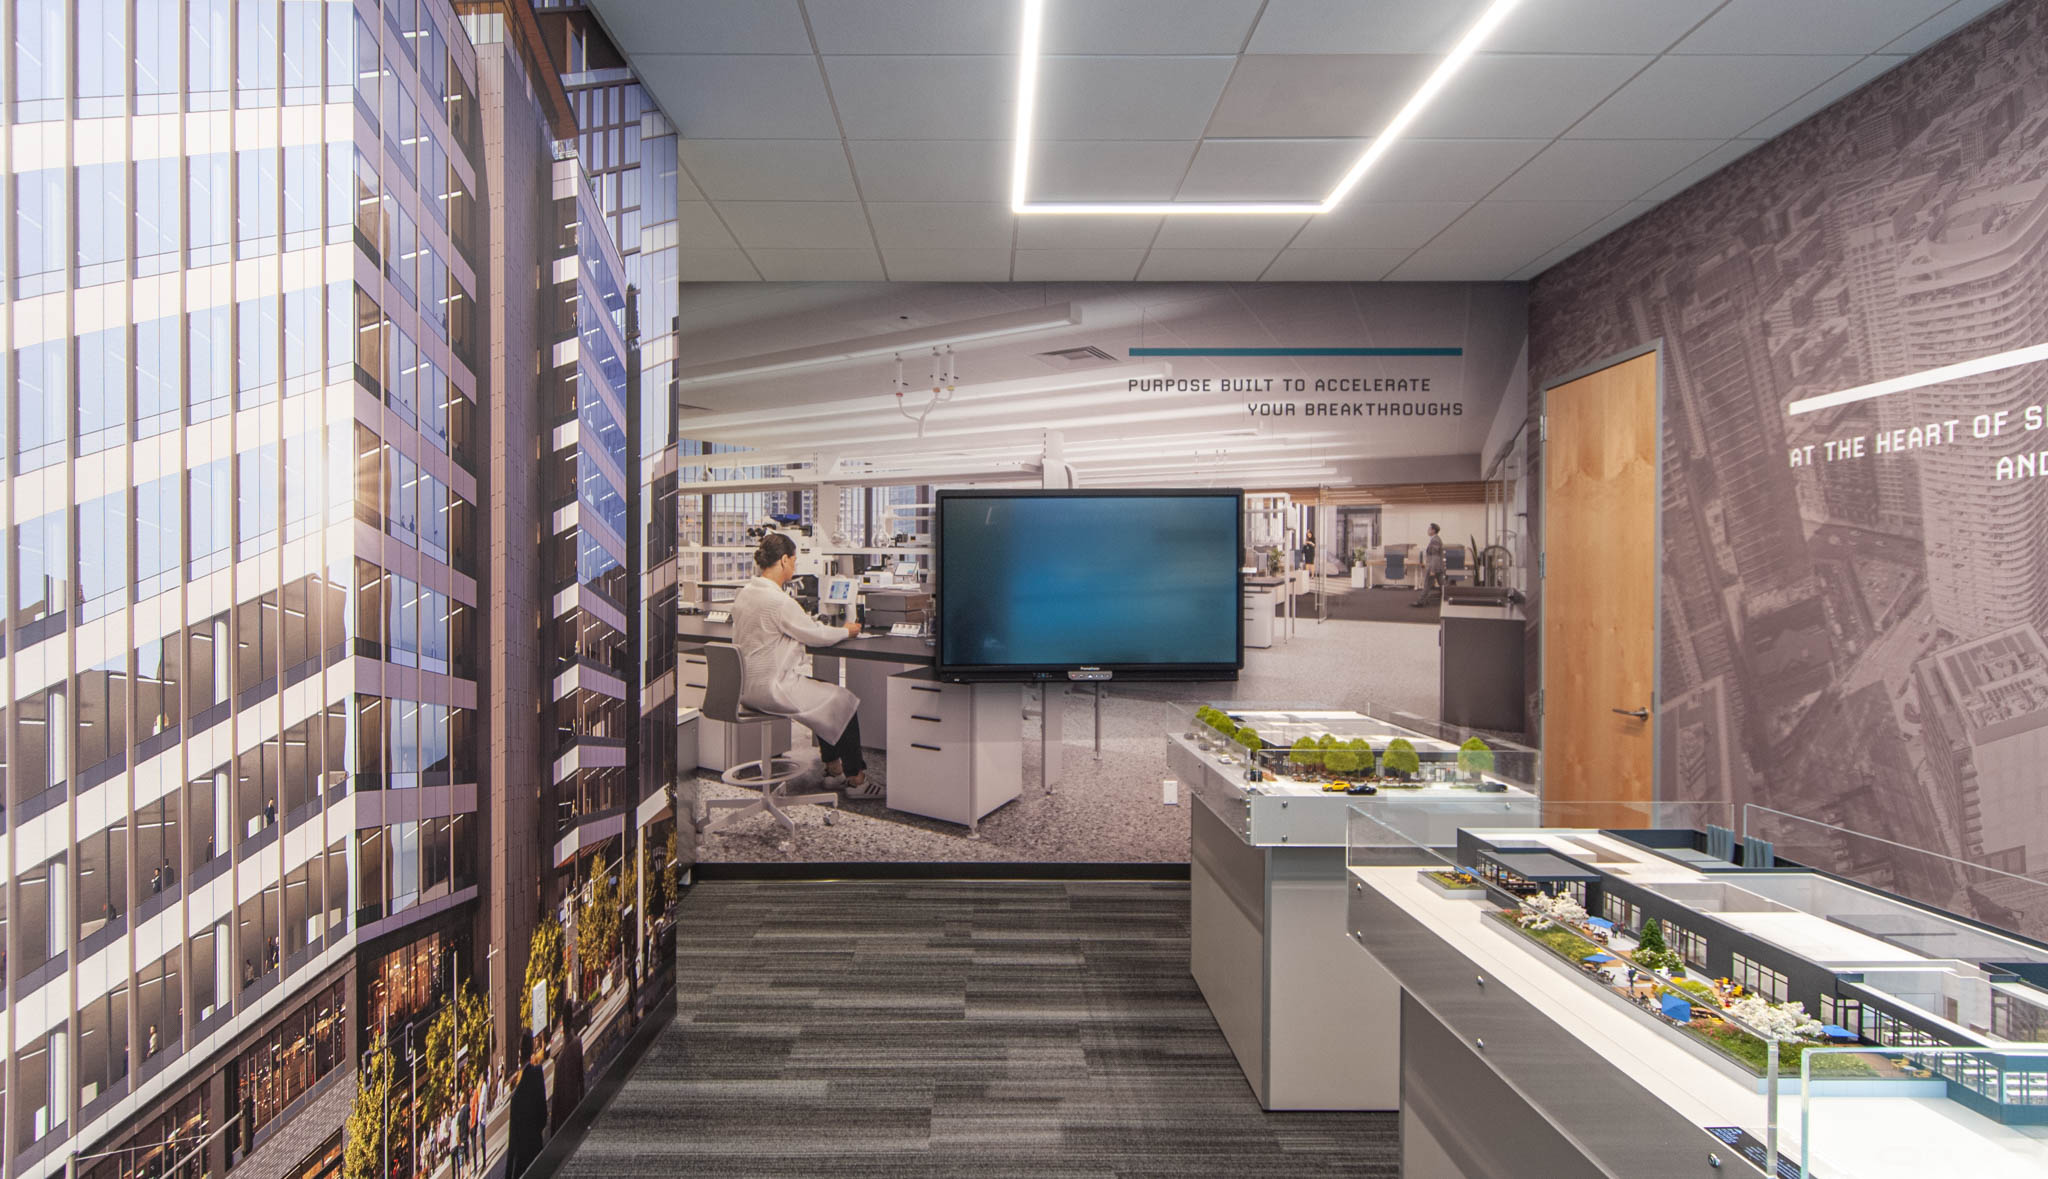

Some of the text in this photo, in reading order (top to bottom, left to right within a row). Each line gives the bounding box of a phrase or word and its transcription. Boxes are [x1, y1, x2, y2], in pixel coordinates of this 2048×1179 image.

[1128, 378, 1431, 392] PURPOSE BUILT TO ACCELERATE
[1248, 402, 1464, 416] YOUR BREAKTHROUGHS
[1789, 405, 2048, 467] AT THE HEART OF S
